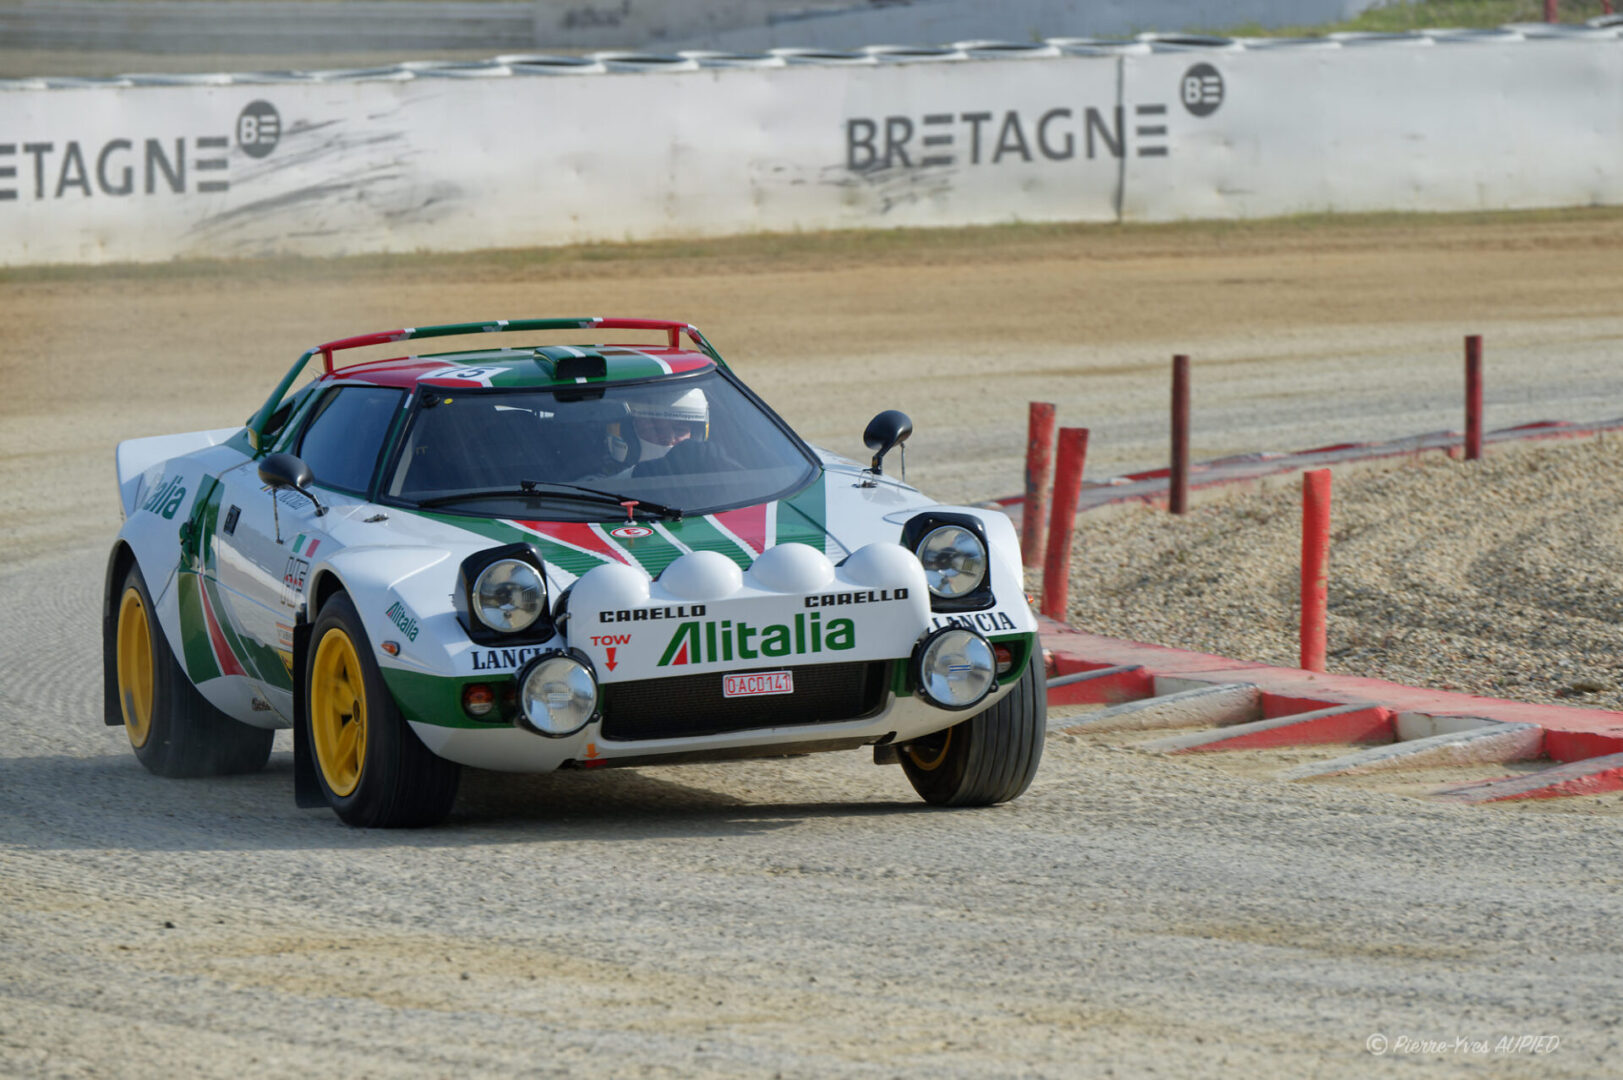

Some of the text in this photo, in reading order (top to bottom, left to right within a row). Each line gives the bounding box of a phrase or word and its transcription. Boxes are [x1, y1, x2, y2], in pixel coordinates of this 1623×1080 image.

[846, 104, 1169, 171] BRETAGNE
[804, 588, 908, 608] CARELLO
[385, 601, 419, 643] Alitalia
[599, 605, 706, 623] CARELLO
[591, 634, 632, 647] TOW
[656, 611, 856, 667] Alitalia
